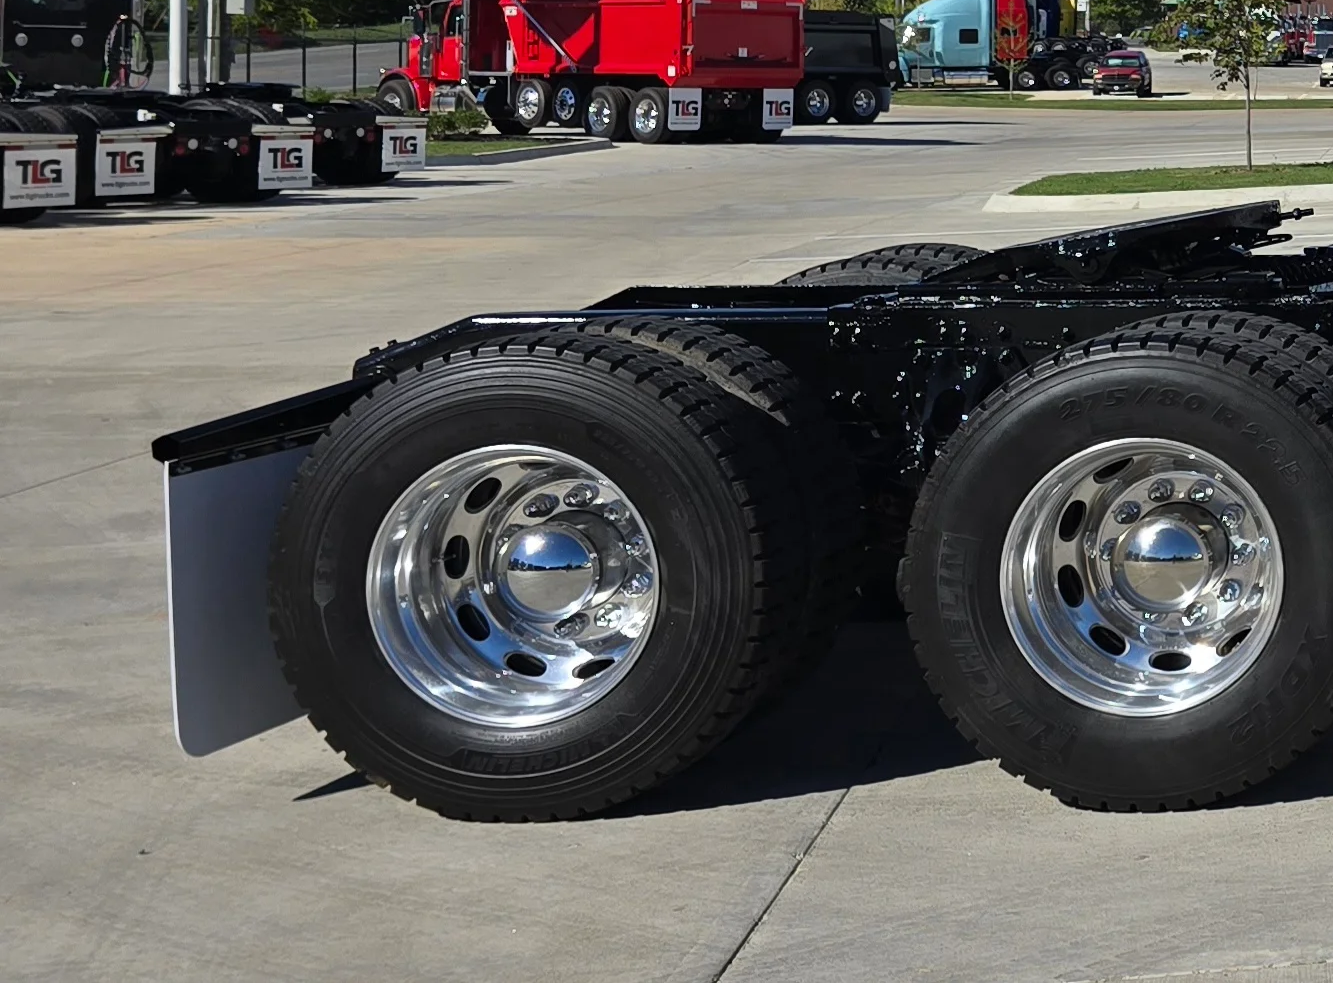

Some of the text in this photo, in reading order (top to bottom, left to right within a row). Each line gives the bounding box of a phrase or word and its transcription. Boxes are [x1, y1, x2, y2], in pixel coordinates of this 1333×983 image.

[672, 100, 699, 117] TLG
[765, 100, 791, 117] TLG
[389, 136, 418, 155] TLG
[105, 150, 145, 175] TLG
[268, 147, 304, 170] TLG
[15, 159, 63, 185] TLG
